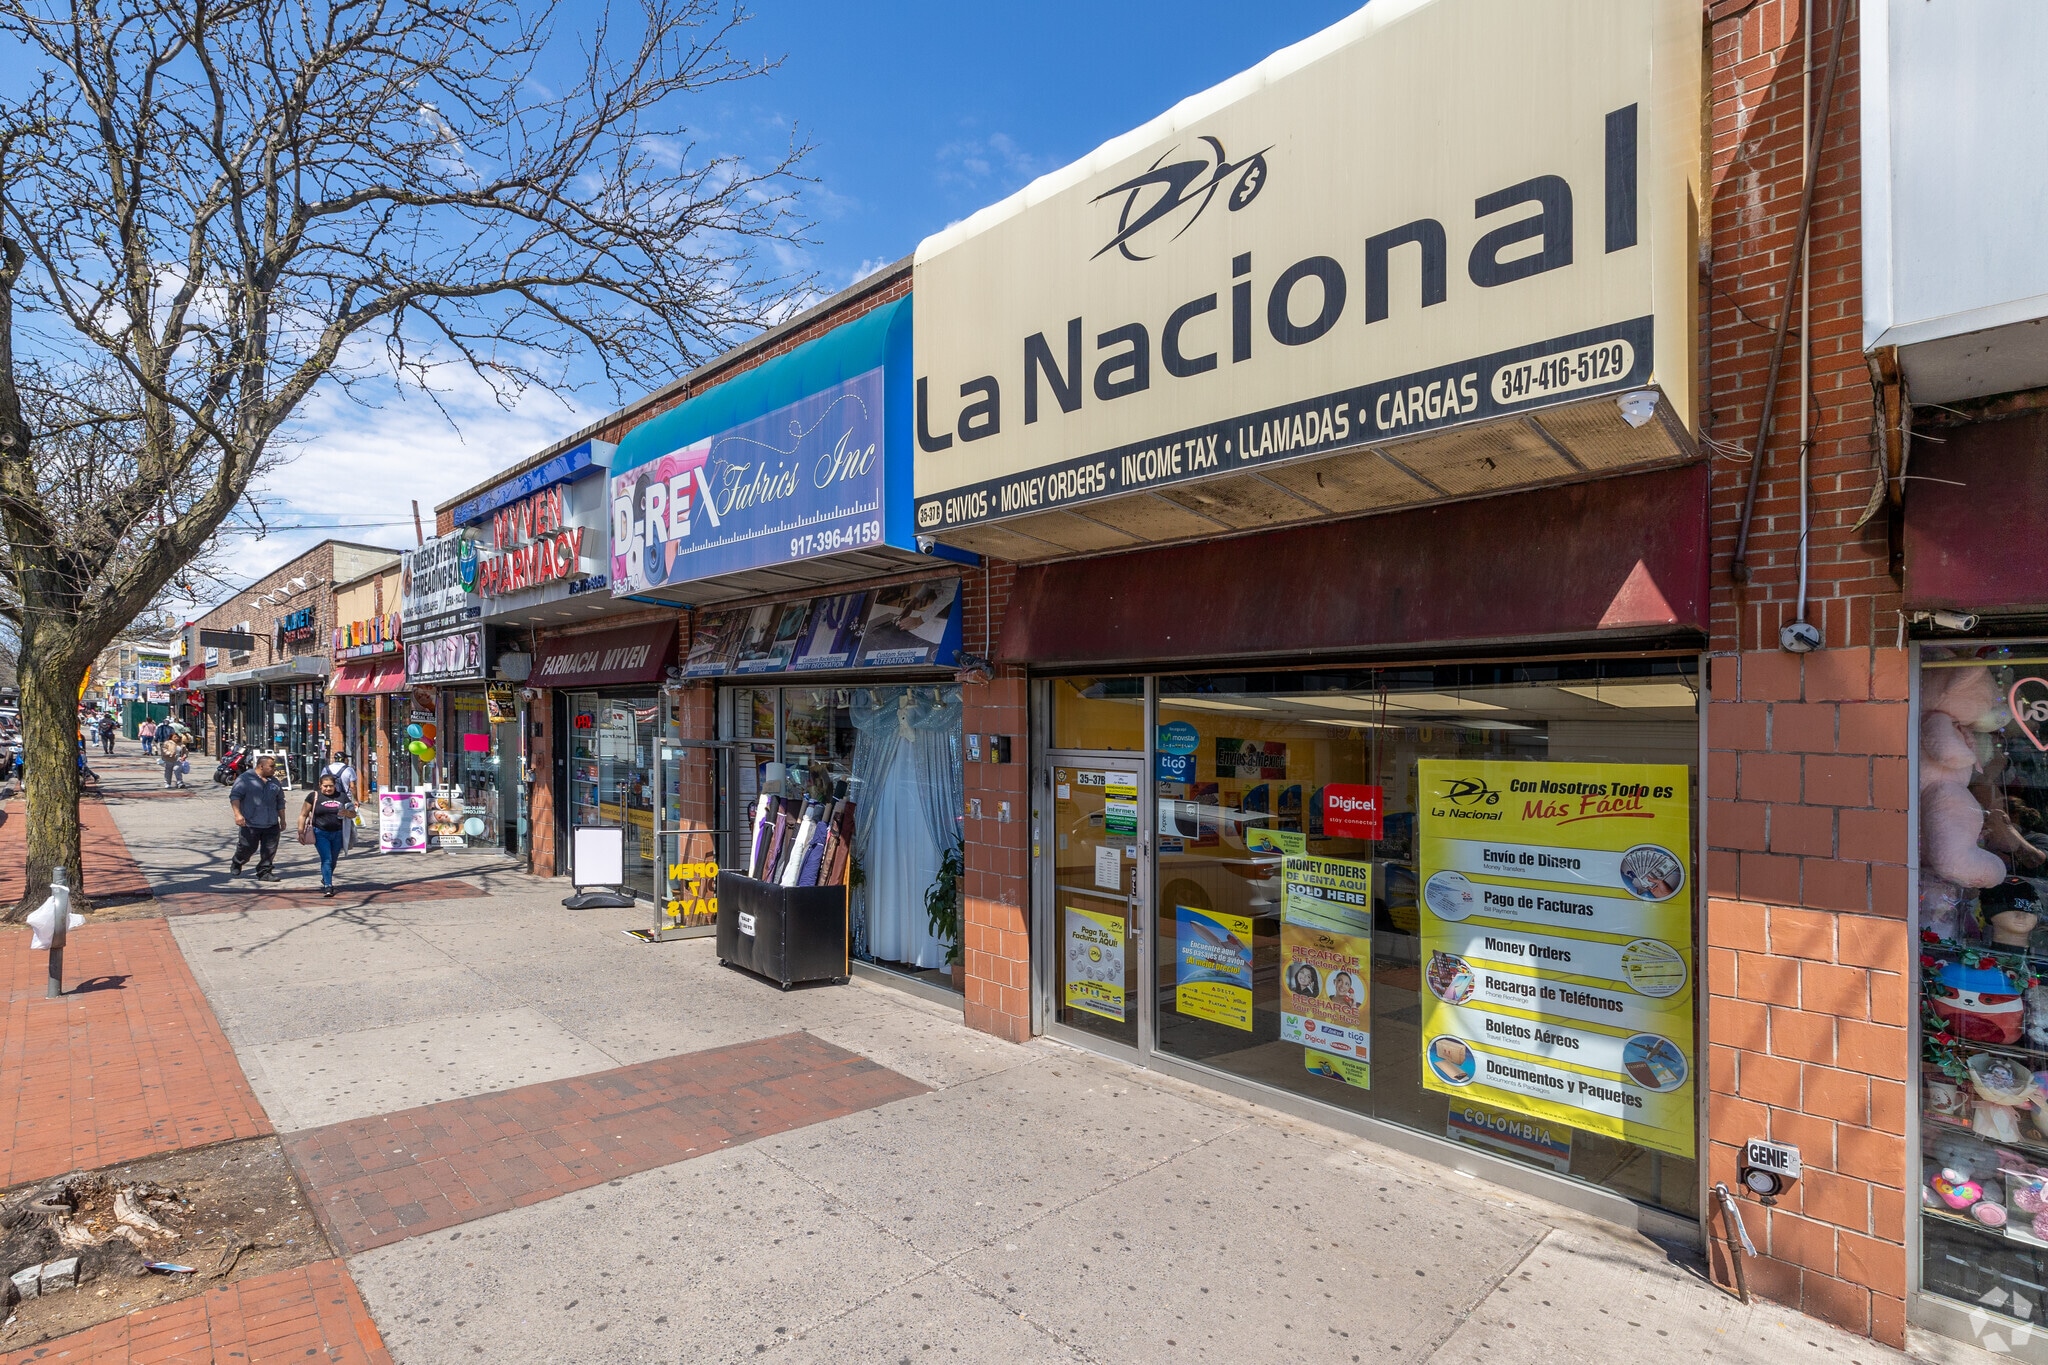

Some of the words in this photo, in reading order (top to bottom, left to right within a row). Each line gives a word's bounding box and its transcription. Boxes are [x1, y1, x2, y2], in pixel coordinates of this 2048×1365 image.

[916, 375, 1000, 453] La
[1023, 102, 1638, 425] Nacional
[920, 506, 936, 523] 35-37
[946, 490, 987, 524] ENVIOS
[1001, 476, 1046, 513] MONEY
[1048, 462, 1105, 500] ORDERS
[1121, 444, 1182, 487] INCOME
[1184, 434, 1218, 472] TAX
[1239, 403, 1349, 460] LLAMADAS
[1376, 373, 1478, 430] CARGAS
[1502, 344, 1623, 399] 347-416-5129
[716, 461, 800, 516] Fabrics
[814, 427, 876, 489] Inc
[494, 483, 562, 551] MYVEN
[791, 520, 880, 557] 917-396-4159
[413, 546, 436, 575] QUEENS
[479, 526, 585, 598] PHARMACY
[413, 565, 447, 599] THREADING
[540, 651, 600, 676] FARMACIA
[600, 644, 651, 671] MYVEN
[811, 661, 845, 669] DECORATION
[872, 656, 915, 665] ALTERATIONS
[489, 683, 498, 691] A
[1172, 734, 1196, 742] movistar
[1510, 778, 1538, 793] Con
[1540, 780, 1607, 796] Nosotros
[1611, 782, 1650, 798] Todo
[1653, 785, 1674, 799] es
[1106, 806, 1136, 815] intermex
[1431, 808, 1445, 817] La
[1449, 808, 1503, 821] Nacional
[1521, 799, 1569, 821] Más
[1579, 787, 1643, 816] Fácil
[1344, 818, 1377, 826] connected
[1286, 857, 1322, 875] MONEY
[1324, 862, 1367, 880] ORDERS
[1483, 848, 1519, 864] Envío
[1520, 852, 1535, 866] de
[1538, 853, 1581, 870] Dinero
[1483, 863, 1501, 872] Money
[1286, 871, 1299, 881] DE
[1302, 873, 1337, 887] VENTA
[1339, 879, 1367, 891] AQUÍ
[1287, 883, 1323, 897] SOLD
[1326, 888, 1365, 905] HERE
[1484, 891, 1516, 909] Pago
[1517, 894, 1533, 909] de
[1537, 899, 1594, 917] Facturas
[2014, 897, 2035, 912] NY
[1072, 931, 1098, 944] Facturas
[1081, 925, 1098, 936] Paga
[1098, 929, 1109, 938] Tus
[1181, 947, 1193, 955] sus
[1193, 949, 1218, 961] pasajes
[1217, 952, 1226, 962] de
[1226, 956, 1245, 966] avión
[1190, 940, 1221, 954] Encuentre
[1292, 945, 1360, 967] RECARGUE
[1485, 937, 1526, 958] Money
[1528, 941, 1571, 963] Orders
[1195, 959, 1216, 969] mejor
[1215, 962, 1241, 974] precio!
[1291, 954, 1302, 963] Su
[1217, 987, 1235, 996] DELTA
[1485, 975, 1536, 998] Recarga
[1540, 985, 1556, 1000] de
[1559, 988, 1624, 1013] Teléfonos
[1292, 993, 1360, 1017] RECHARGE
[1292, 1002, 1310, 1014] Your
[1312, 1007, 1338, 1021] Phone
[1339, 1013, 1360, 1026] Here
[1305, 1033, 1326, 1045] Digicel
[1485, 1018, 1531, 1040] Boletos
[1534, 1028, 1580, 1050] Aéreos
[1486, 1059, 1564, 1090] Documentos
[1567, 1080, 1575, 1094] y
[1578, 1080, 1643, 1109] Paquetes
[1463, 1108, 1552, 1146] COLOMBIA
[1749, 1144, 1788, 1169] GENIE
